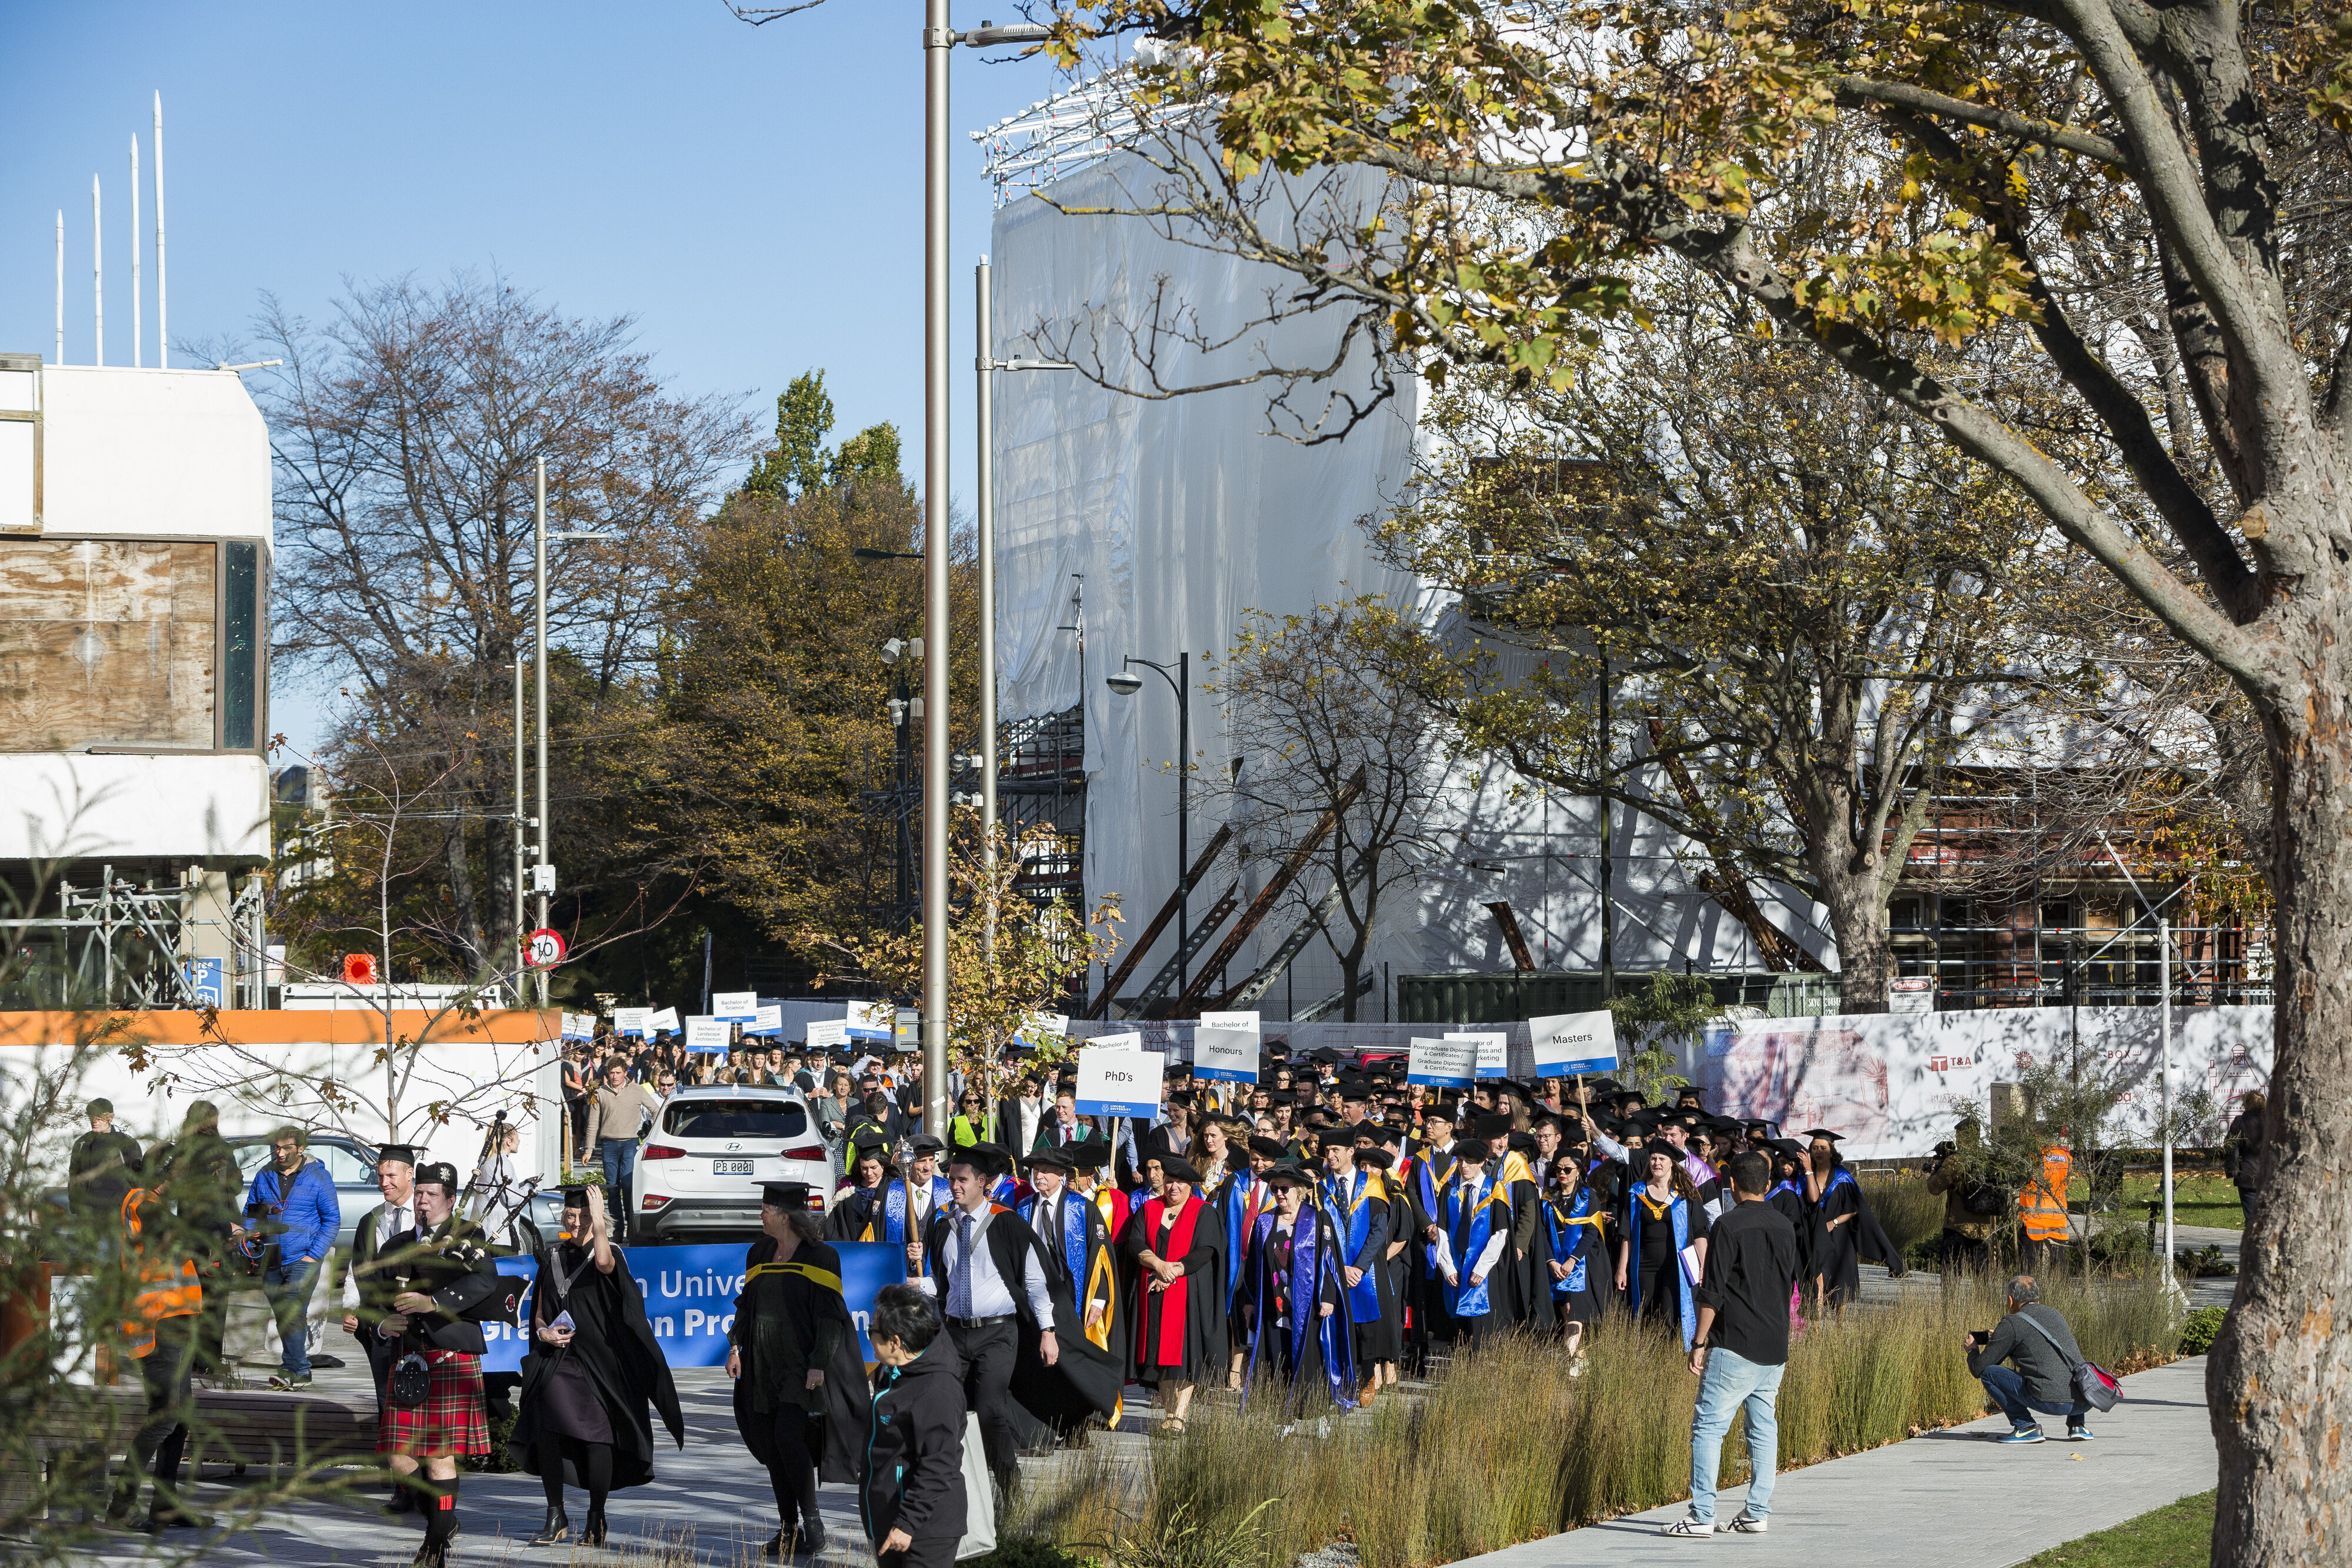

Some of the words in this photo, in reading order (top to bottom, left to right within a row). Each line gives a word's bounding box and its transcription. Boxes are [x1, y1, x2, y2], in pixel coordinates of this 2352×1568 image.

[537, 942, 553, 957] 10
[649, 1019, 670, 1028] Diplomas
[1552, 1034, 1593, 1045] Masters
[1209, 1045, 1243, 1056] Honours
[1413, 1044, 1449, 1052] Postgraduate
[2107, 1050, 2131, 1059] BOX
[1950, 1056, 1972, 1066] T&A
[716, 1163, 728, 1172] PB
[731, 1162, 752, 1172] 0001
